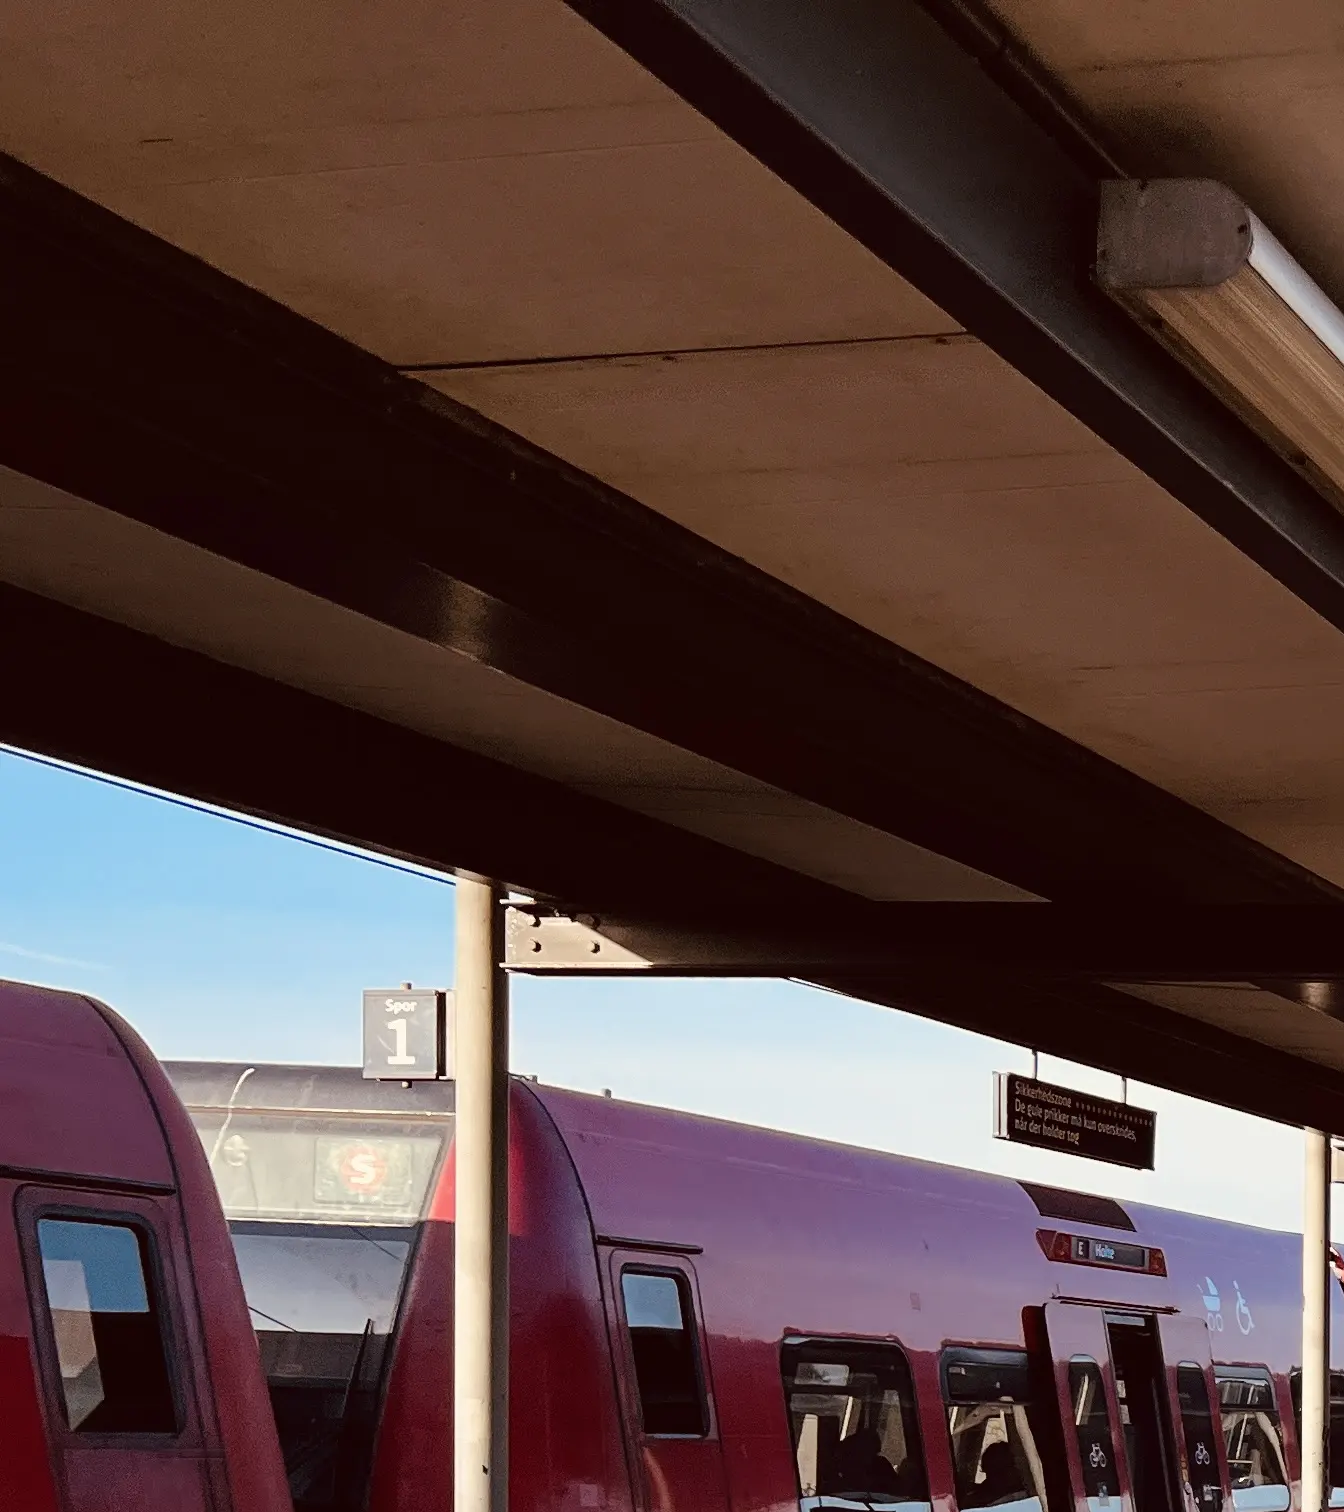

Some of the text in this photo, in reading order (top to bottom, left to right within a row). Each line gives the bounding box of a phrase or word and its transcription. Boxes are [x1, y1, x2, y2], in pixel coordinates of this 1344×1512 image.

[385, 999, 417, 1015] Spor
[387, 1018, 416, 1065] 1
[1015, 1080, 1072, 1108] Sikkerhedszone
[1015, 1098, 1026, 1114] De
[1044, 1108, 1070, 1124] prikker
[1028, 1119, 1041, 1134] der
[1067, 1130, 1080, 1146] tog
[350, 1153, 377, 1185] S
